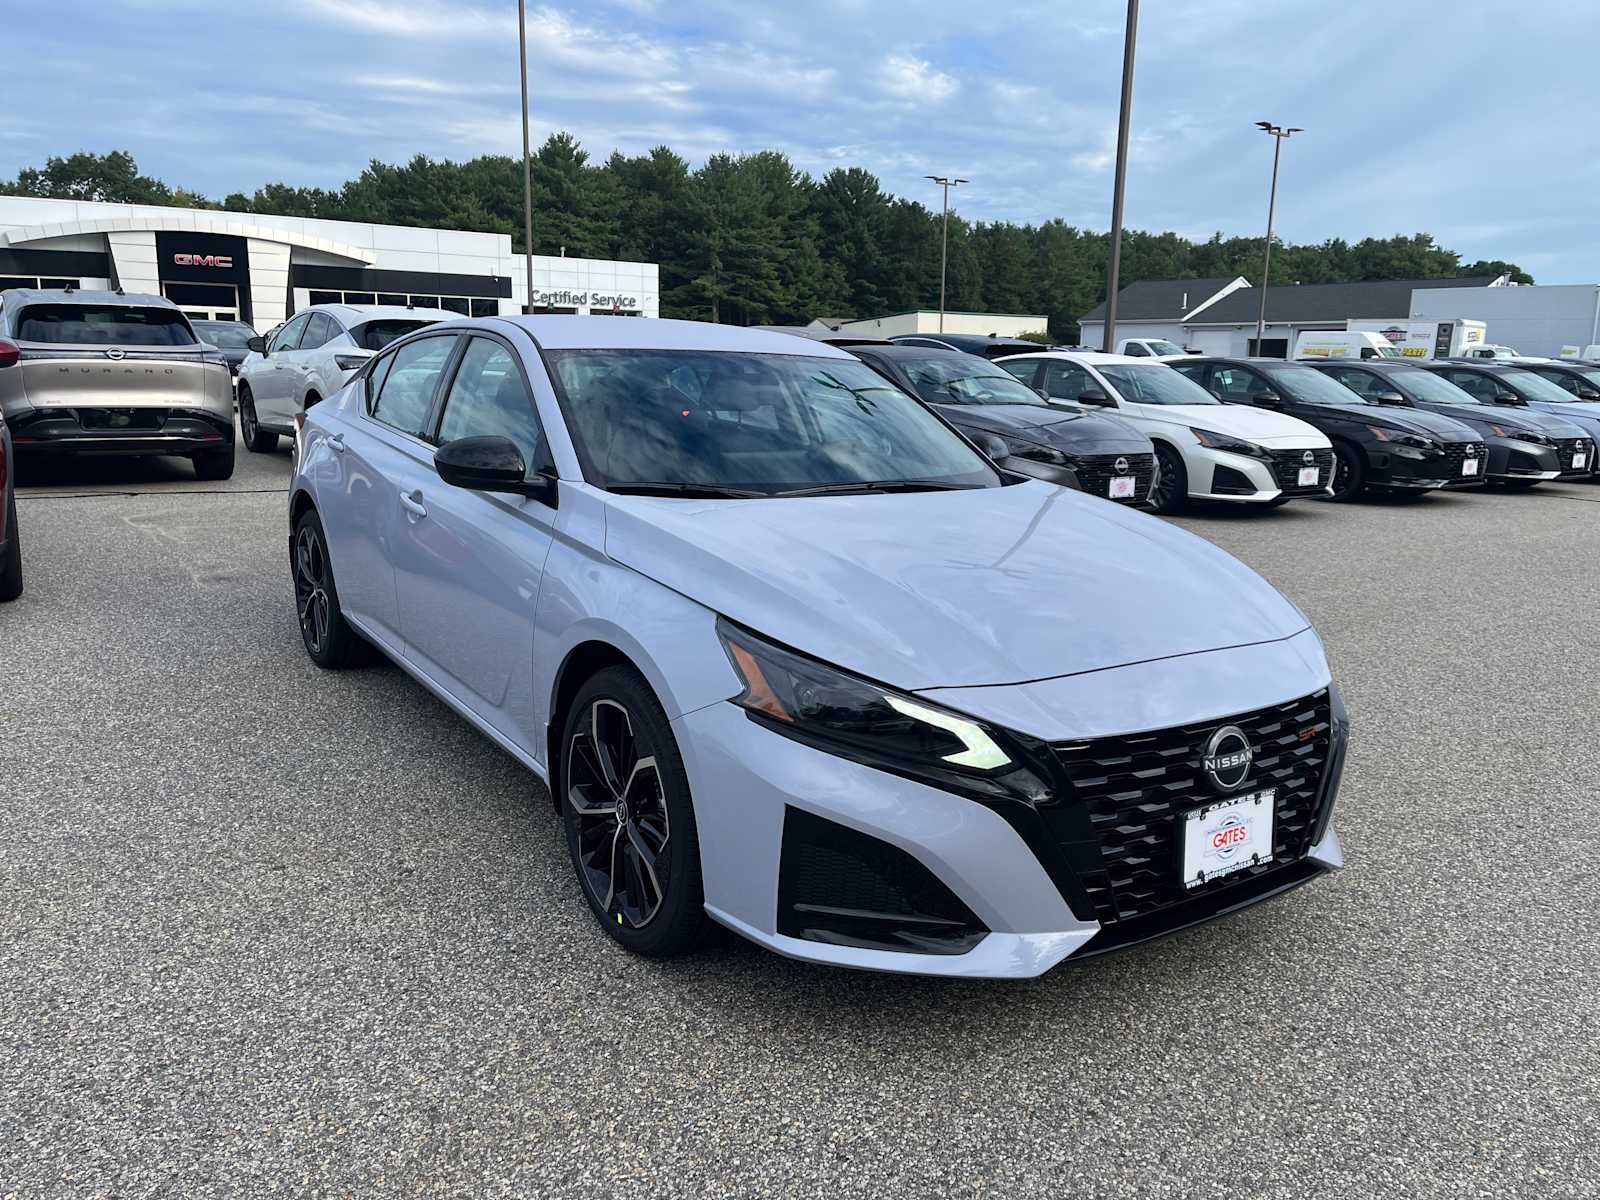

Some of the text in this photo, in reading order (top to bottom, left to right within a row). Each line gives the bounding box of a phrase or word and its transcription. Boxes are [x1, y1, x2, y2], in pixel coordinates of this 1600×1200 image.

[174, 253, 233, 268] GMC
[532, 289, 637, 307] Certified Service
[58, 367, 173, 375] MURANO
[1204, 750, 1252, 770] NISSAN
[1213, 826, 1246, 848] GATES
